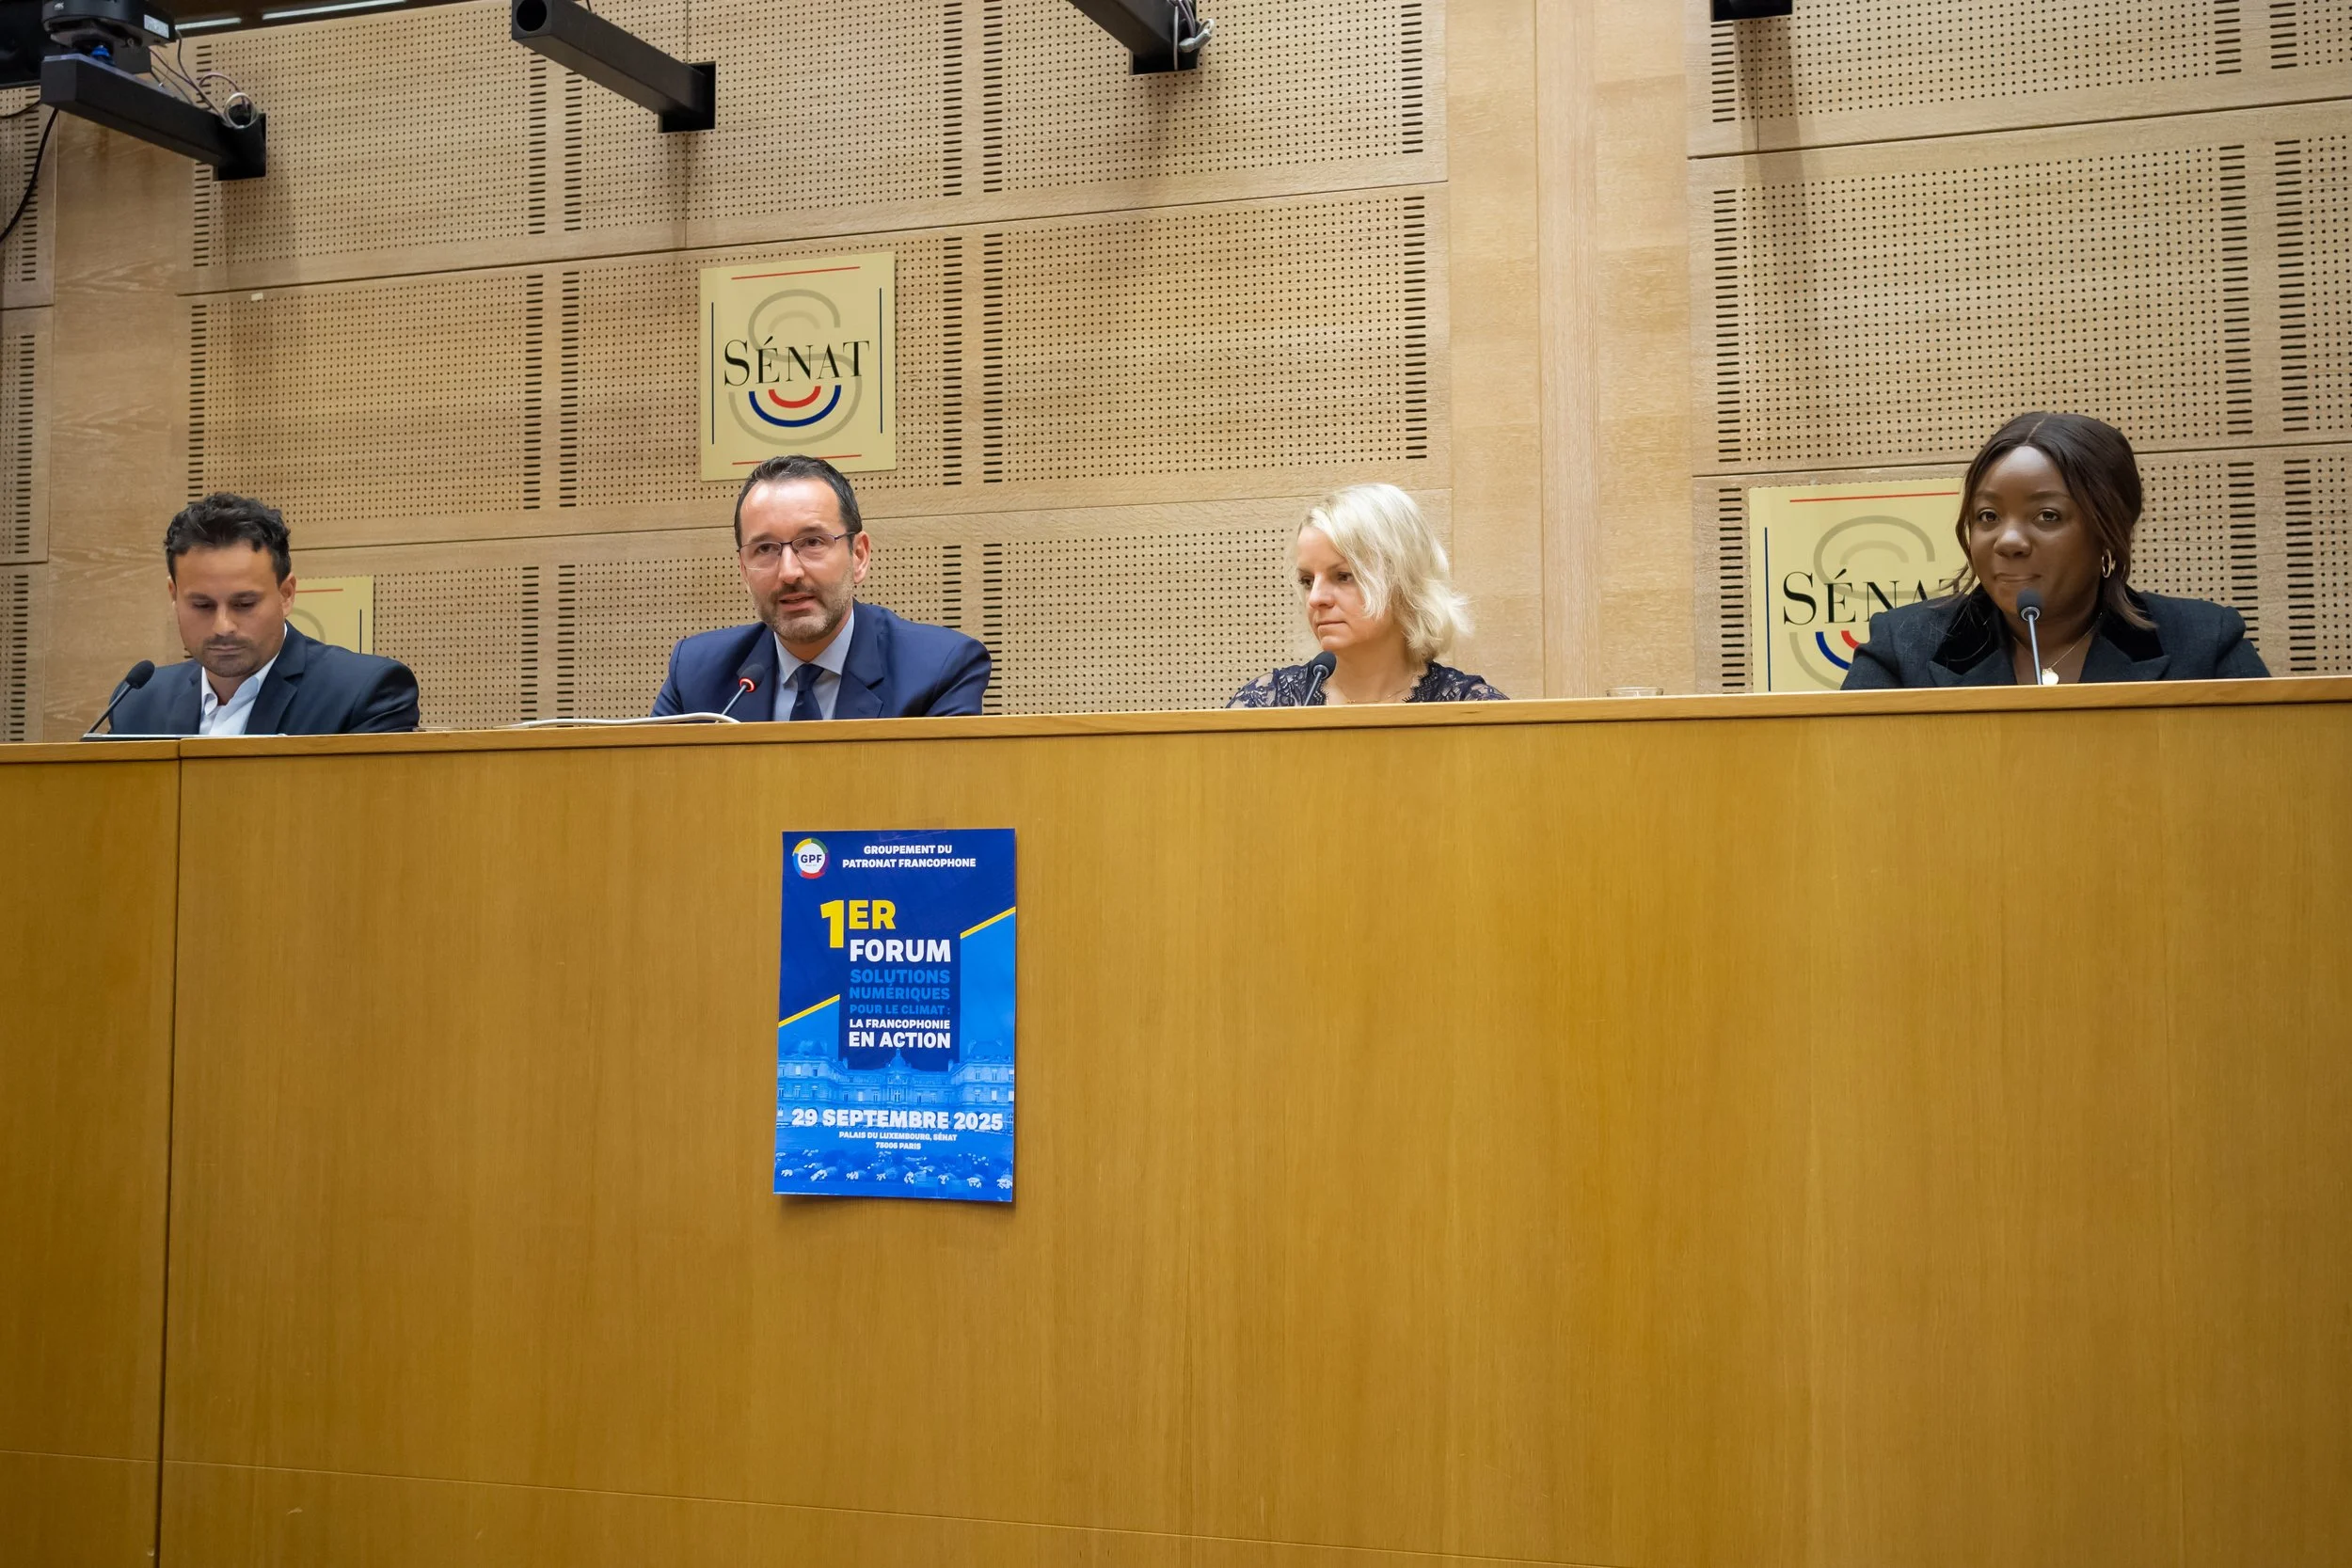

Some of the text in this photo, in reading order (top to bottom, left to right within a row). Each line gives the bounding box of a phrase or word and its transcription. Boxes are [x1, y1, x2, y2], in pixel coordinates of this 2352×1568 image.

[723, 335, 870, 387] SÉNAT
[864, 845, 952, 854] GROUPEMENT DU
[800, 854, 823, 863] GPF
[842, 858, 977, 868] PATRONAT FRANCOPHONE
[850, 939, 951, 962] FORUM
[850, 969, 950, 984] SOLUTIONS
[850, 982, 950, 1002] NUMÉRIQUES
[850, 1005, 882, 1014] POUR
[885, 1005, 898, 1014] LE
[901, 1005, 945, 1015] CLIMAT
[850, 1019, 950, 1029] LA FRANCOPHONIE
[849, 1032, 950, 1048] EN ACTION
[791, 1108, 1003, 1131] 29 SEPTEMBRE 2025
[880, 1132, 932, 1141] LUXEMBOURG,
[933, 1132, 958, 1141] SÉNAT
